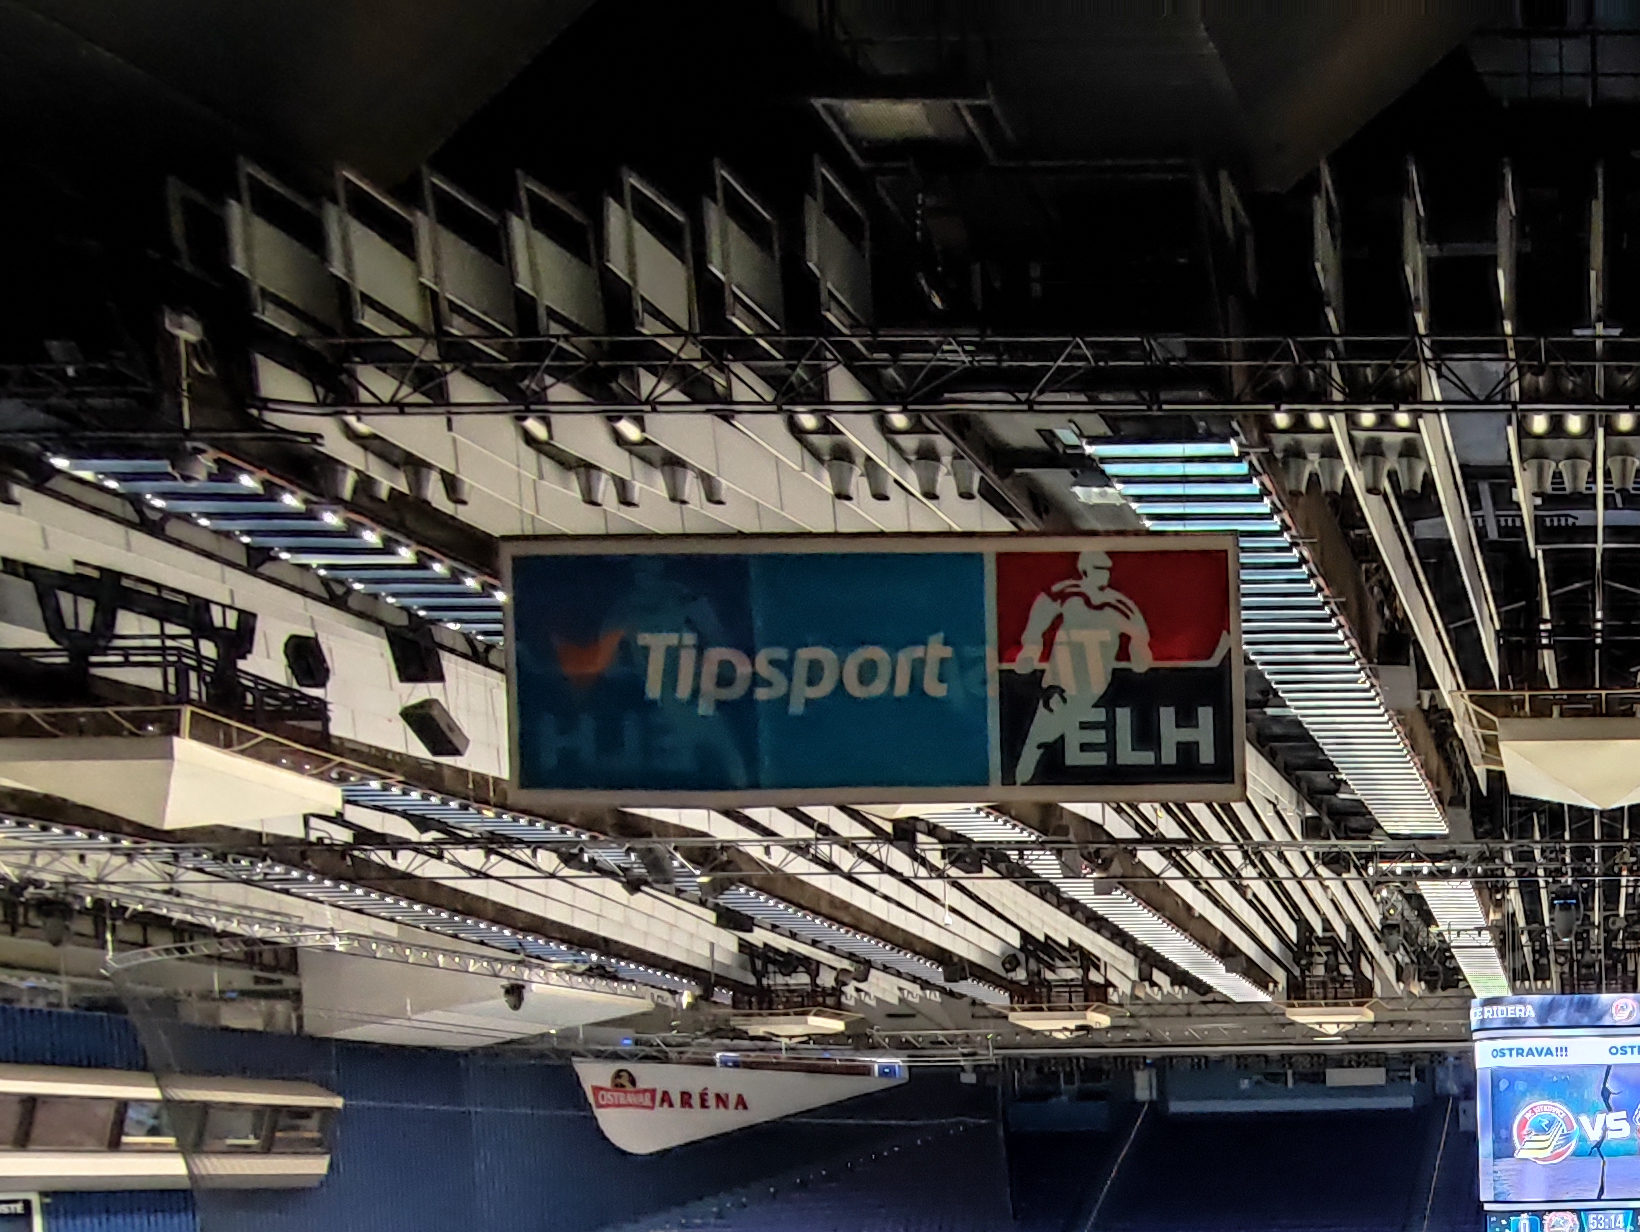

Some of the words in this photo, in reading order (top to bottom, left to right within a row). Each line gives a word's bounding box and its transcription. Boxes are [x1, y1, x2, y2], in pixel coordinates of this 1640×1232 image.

[636, 628, 954, 717] Tipsport
[1064, 705, 1216, 767] ELH
[1485, 1004, 1536, 1019] RIDERA
[1491, 1046, 1569, 1059] OSTRAVA!!!
[659, 1087, 749, 1111] ARÉNA
[1578, 1111, 1631, 1142] VS
[1589, 1212, 1625, 1230] 53:14
